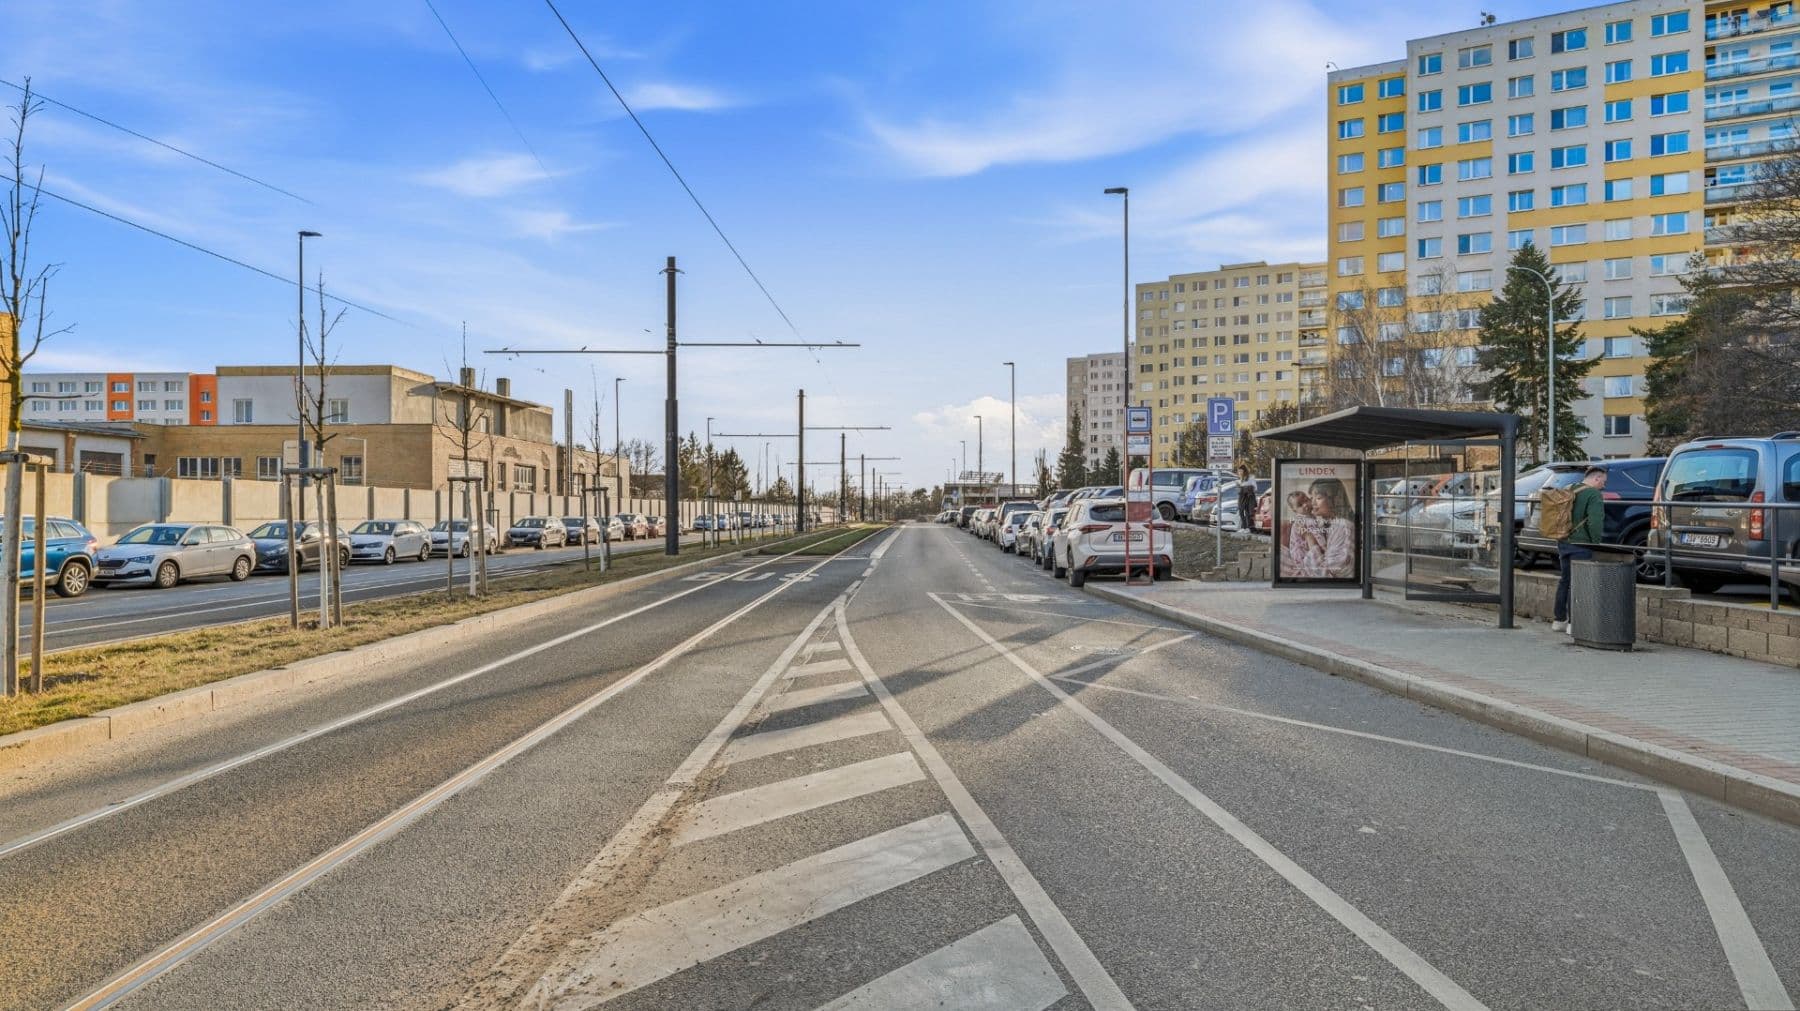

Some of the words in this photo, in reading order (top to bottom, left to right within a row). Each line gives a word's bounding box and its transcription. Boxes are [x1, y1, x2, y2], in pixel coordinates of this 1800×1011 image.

[1214, 402, 1228, 424] P
[1298, 466, 1336, 476] LINDEX
[681, 571, 820, 582] BUS
